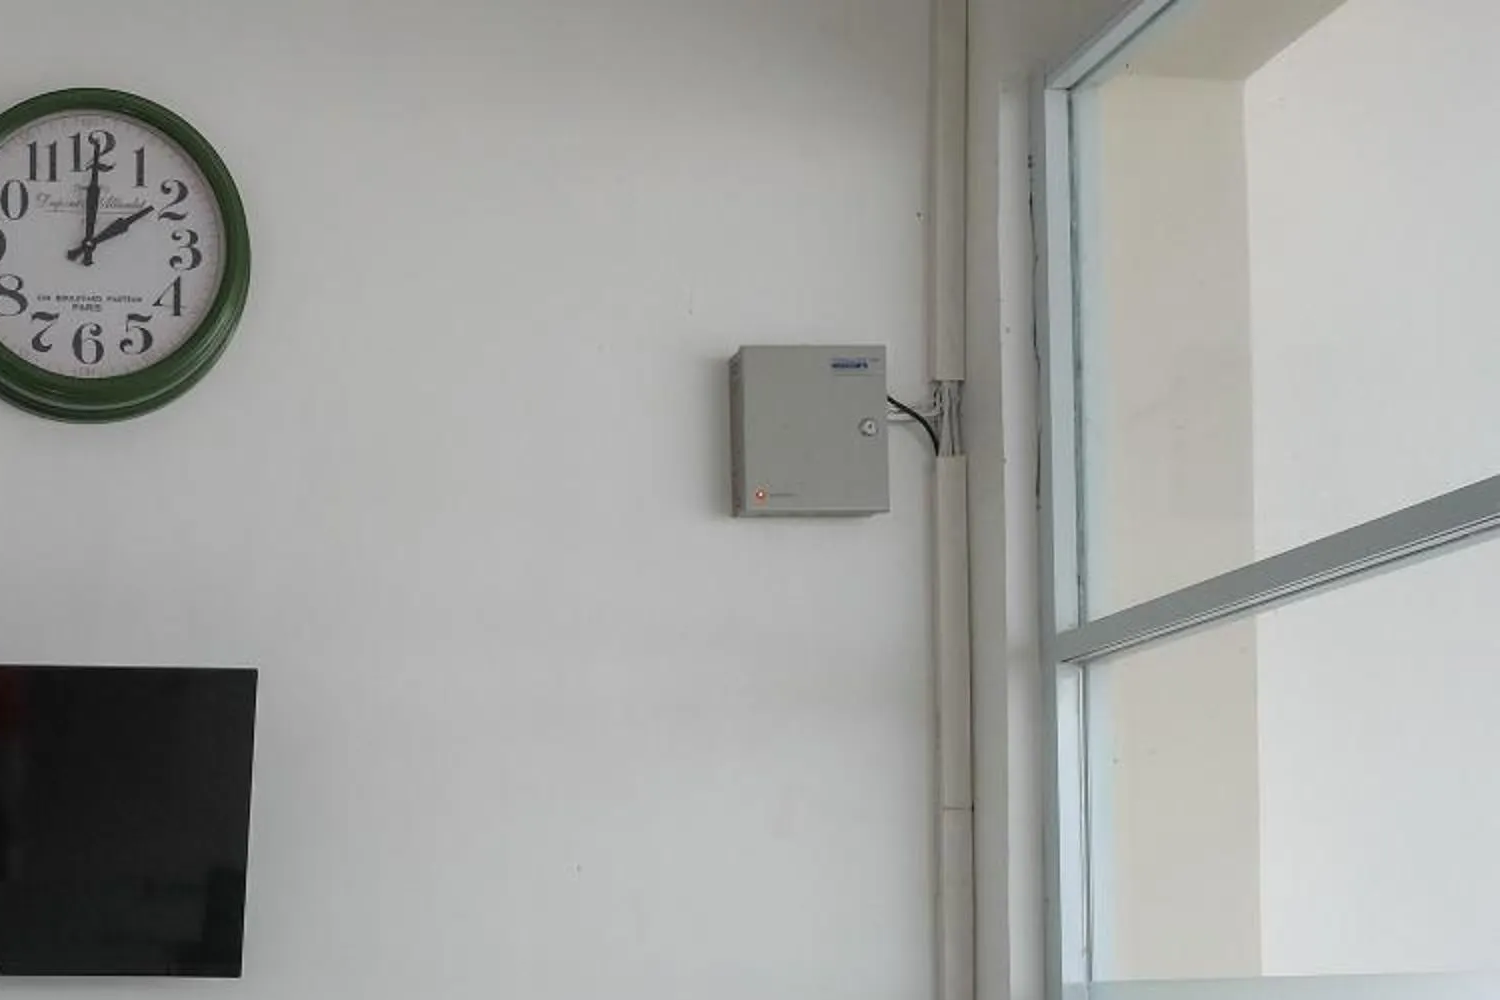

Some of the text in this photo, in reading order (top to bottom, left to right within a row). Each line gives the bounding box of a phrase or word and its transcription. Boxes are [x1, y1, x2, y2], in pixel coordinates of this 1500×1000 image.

[27, 140, 58, 182] 11
[68, 129, 117, 173] 12
[132, 146, 148, 188] 1
[157, 179, 190, 221] 2
[169, 228, 202, 271] 3
[152, 276, 186, 317] 4
[30, 311, 61, 353] 7
[71, 322, 105, 365] 6
[119, 313, 153, 355] 5
